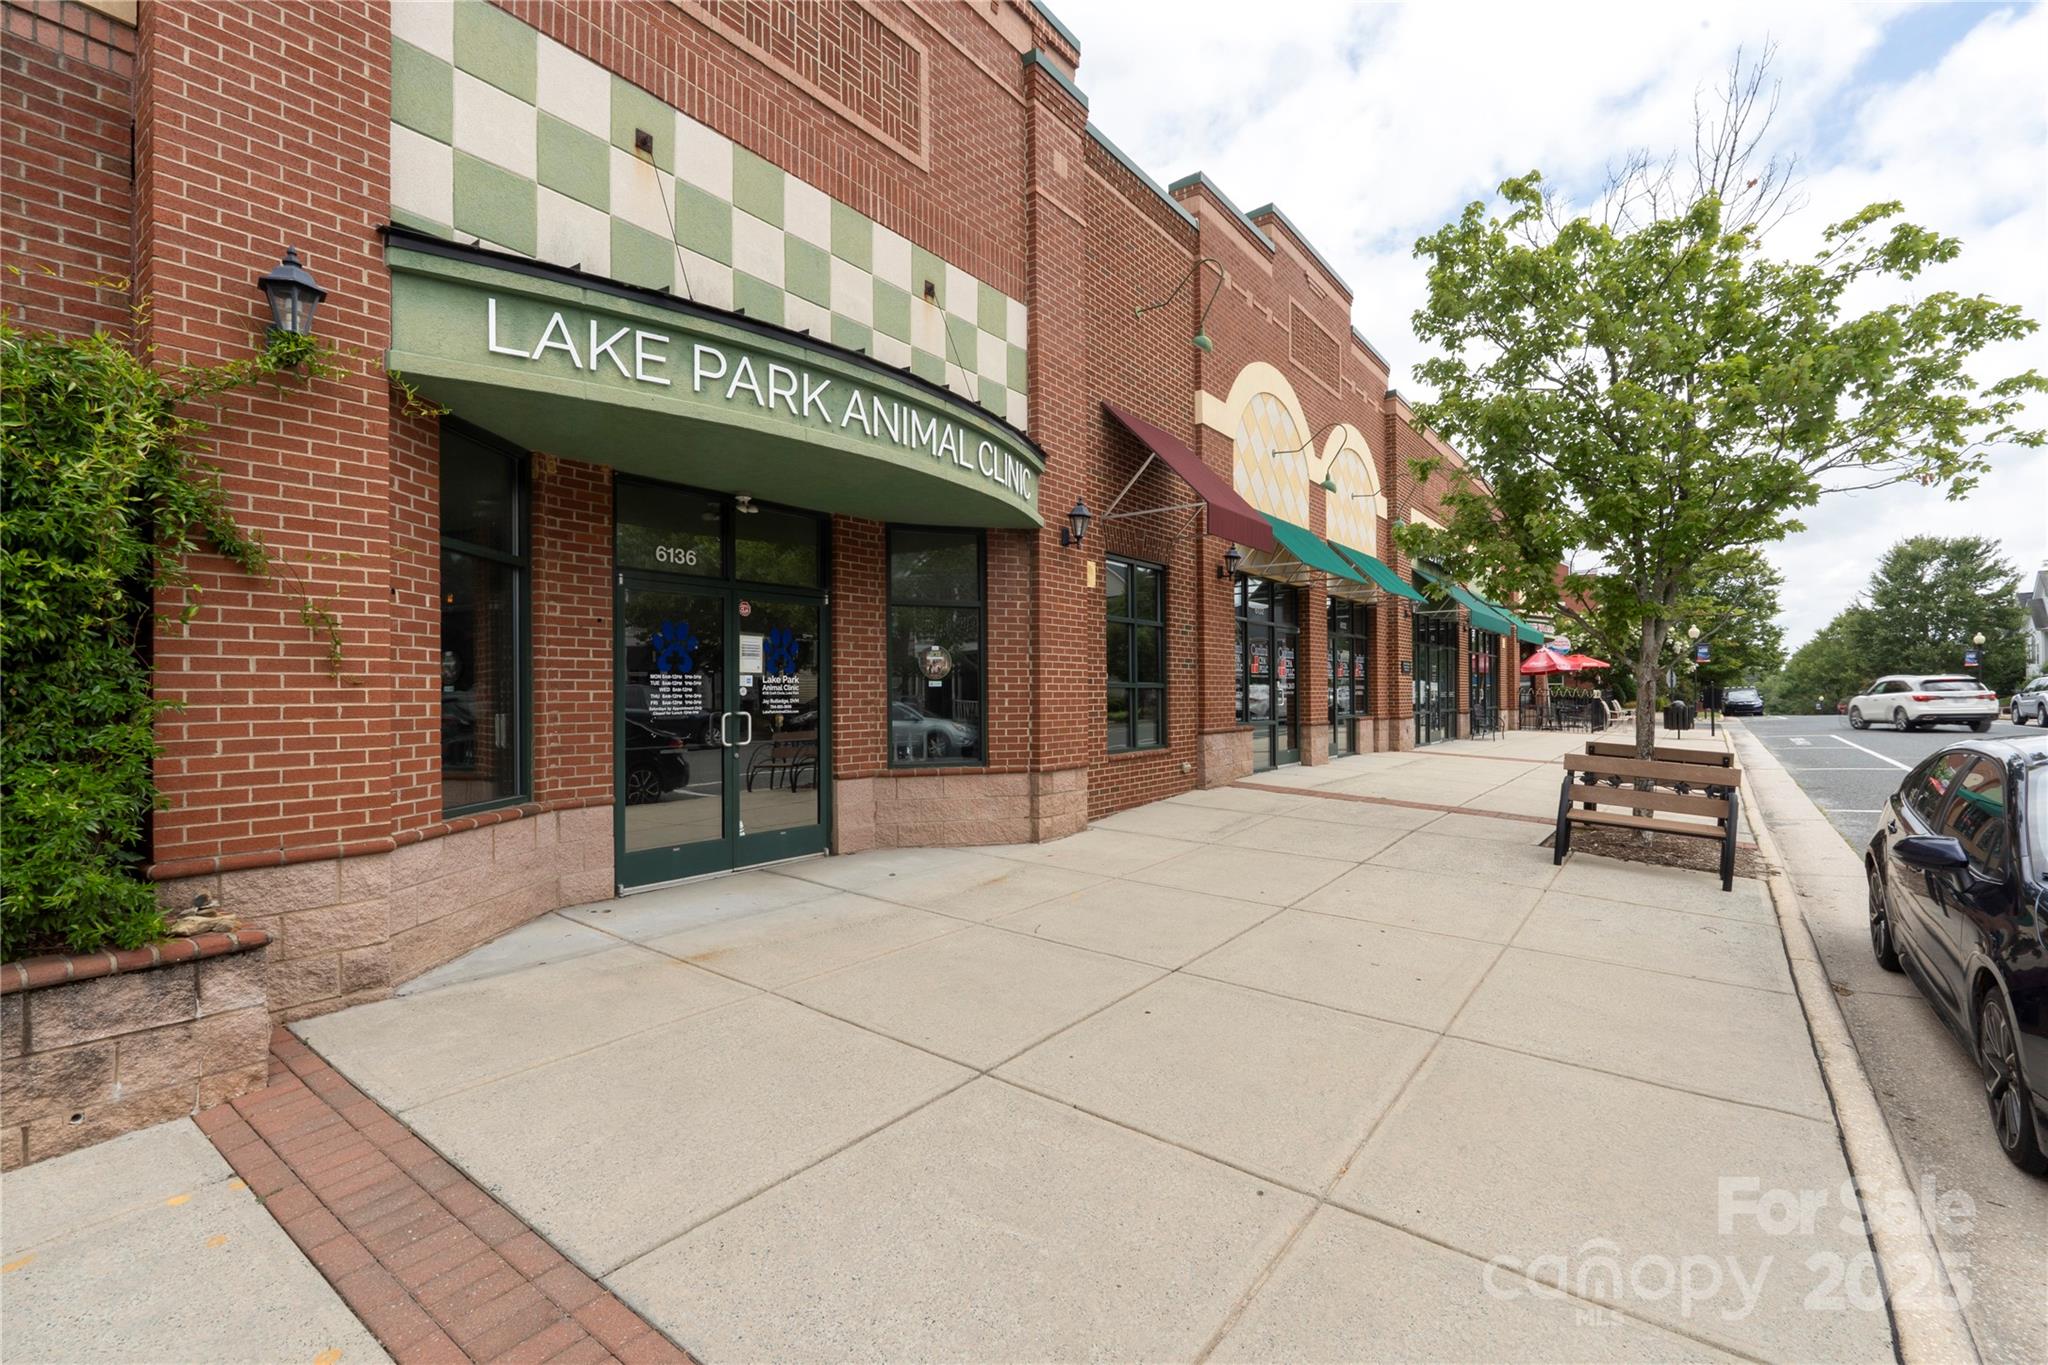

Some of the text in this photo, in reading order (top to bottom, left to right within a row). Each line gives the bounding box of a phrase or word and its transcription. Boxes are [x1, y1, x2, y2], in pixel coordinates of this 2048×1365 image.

[487, 298, 1032, 501] LAKE PARK ANIMAL CLINIC
[655, 545, 697, 566] 6136
[762, 675, 781, 684] Lake
[782, 675, 800, 684] Park
